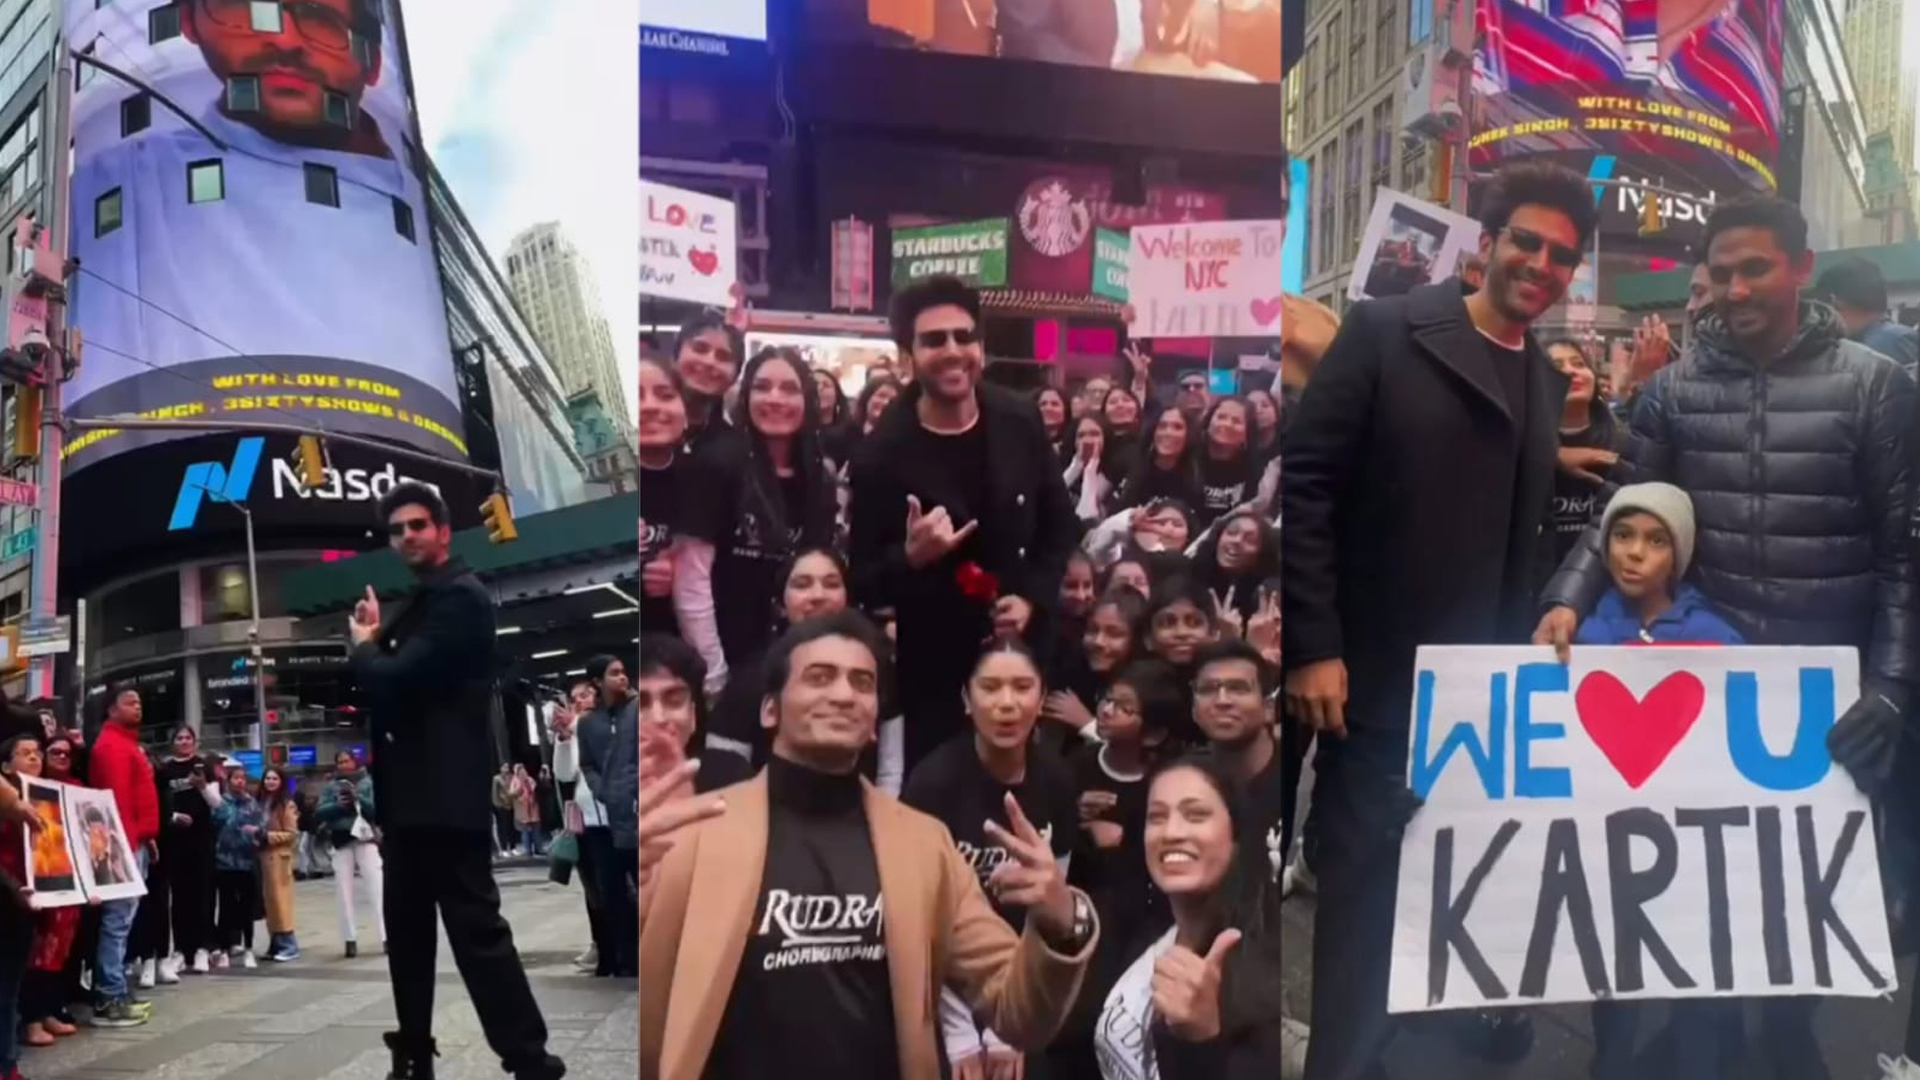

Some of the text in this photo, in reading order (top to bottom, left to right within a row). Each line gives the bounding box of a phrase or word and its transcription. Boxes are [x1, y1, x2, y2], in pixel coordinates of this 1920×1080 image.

[1513, 117, 1570, 135] SINGH
[1584, 116, 1723, 150] 3SIXTYSHOWS
[1578, 97, 1732, 134] WITH LOVE FROM
[648, 194, 718, 235] LOVE
[893, 230, 1005, 258] STARBUCKS
[1137, 226, 1277, 262] Welcome To
[909, 256, 980, 278] COFFEE
[1184, 260, 1229, 291] NYC
[212, 373, 400, 398] WITH LOVE FROM
[223, 394, 395, 418] 3SIXTYSHOWS
[1410, 663, 1836, 800] WE U
[757, 888, 883, 942] RUDRA
[1427, 804, 1897, 1007] KARTIK
